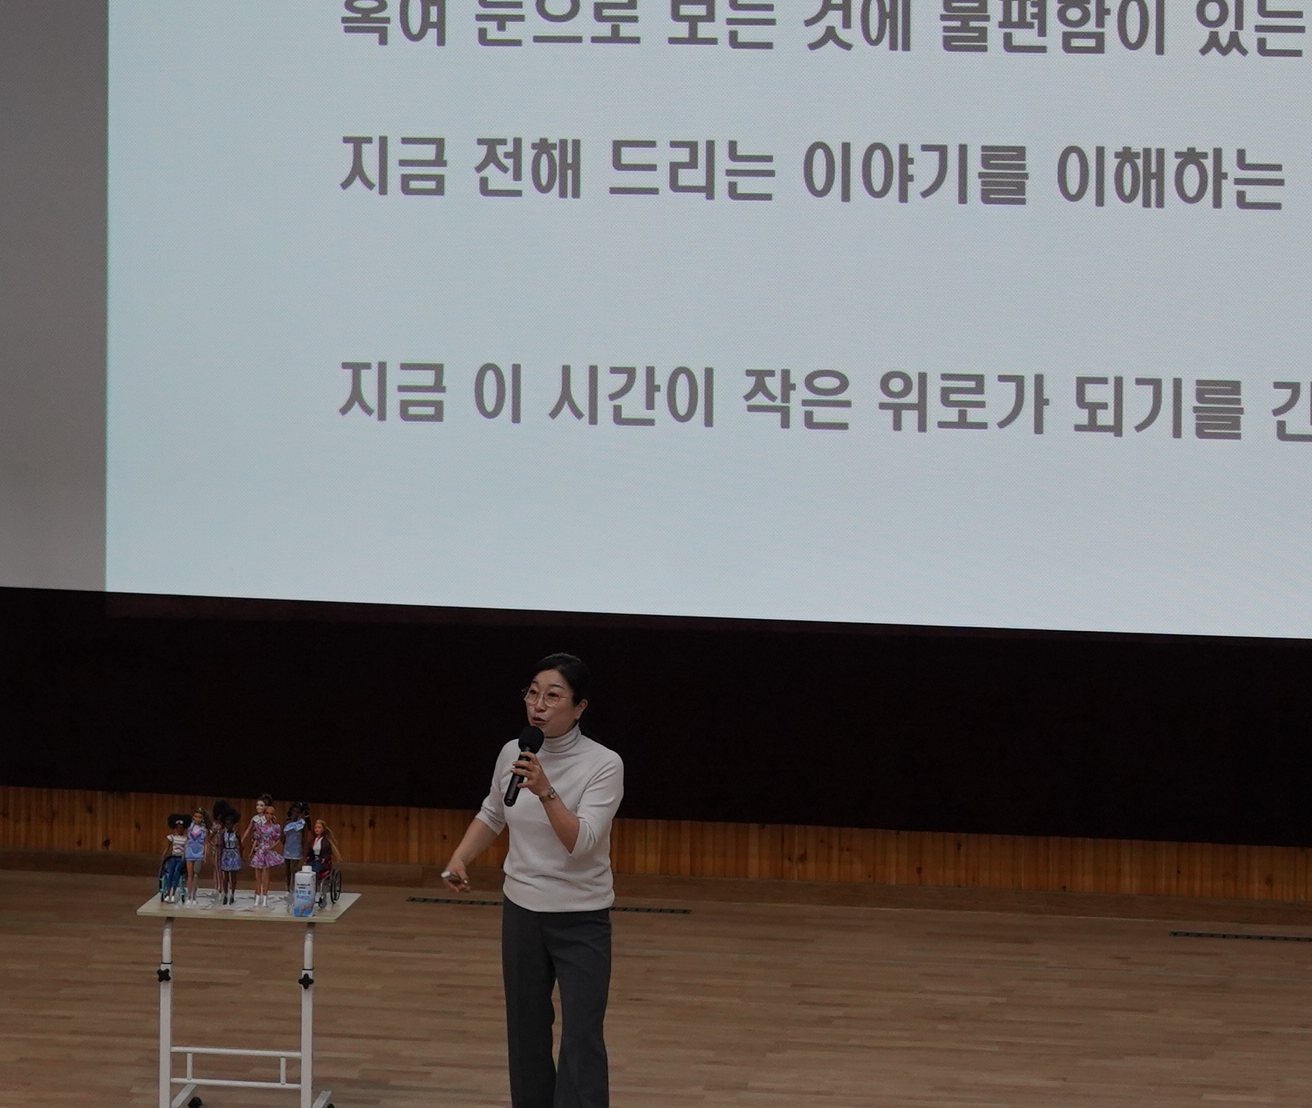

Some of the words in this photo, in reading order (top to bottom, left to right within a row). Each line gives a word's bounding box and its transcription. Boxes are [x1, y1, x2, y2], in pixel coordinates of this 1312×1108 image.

[340, 135, 448, 196] 지금
[475, 137, 581, 199] 전해
[609, 139, 776, 201] 드리는
[803, 141, 1029, 205] 이야기를
[1057, 145, 1285, 210] 이해하는
[340, 361, 446, 422] 지금
[474, 363, 521, 424] 이
[549, 365, 714, 427] 시간이
[743, 369, 852, 430] 작은
[878, 370, 1050, 435] 위로가
[1074, 376, 1244, 440] 되기를
